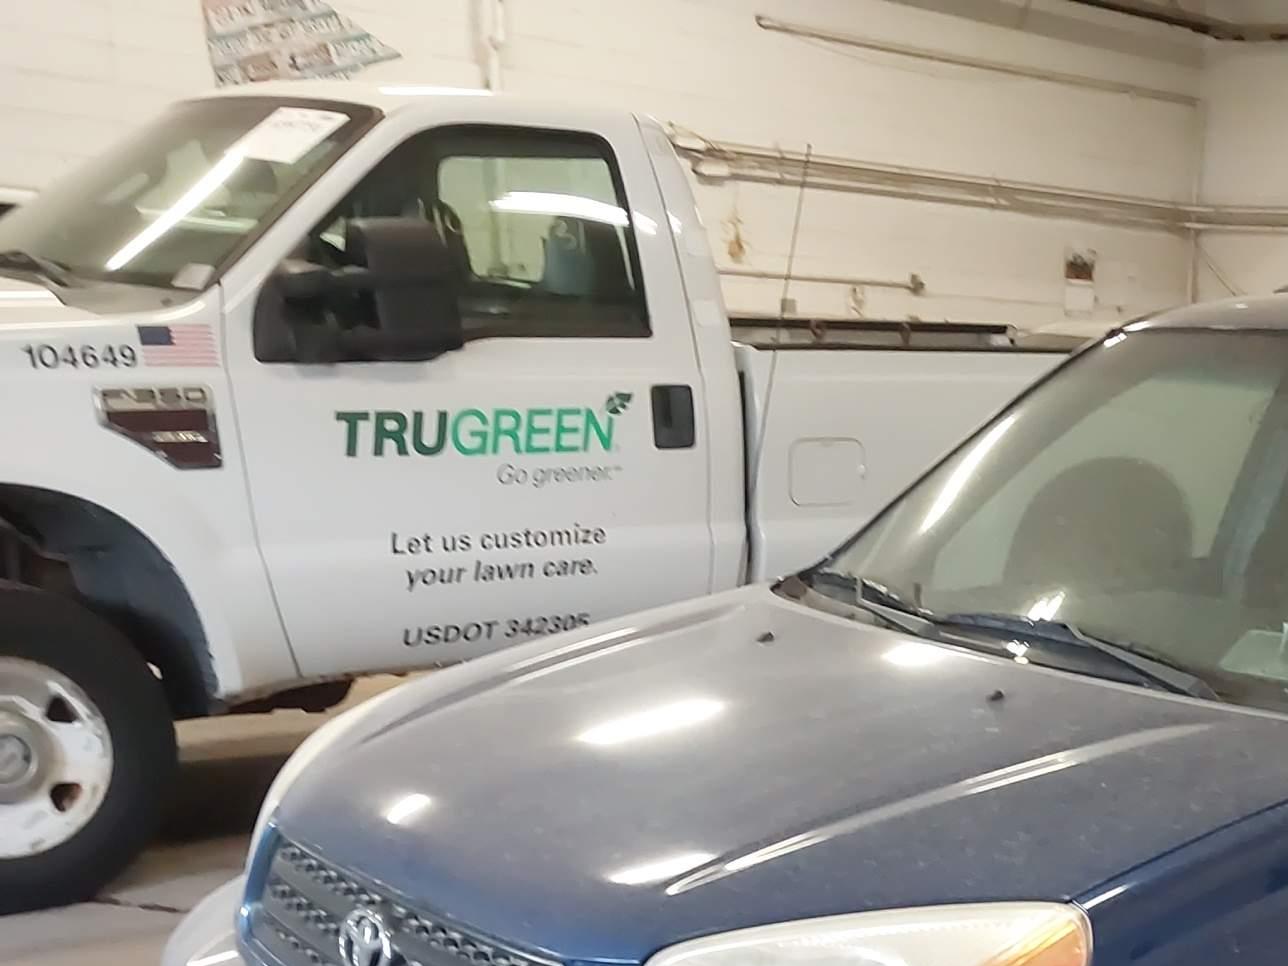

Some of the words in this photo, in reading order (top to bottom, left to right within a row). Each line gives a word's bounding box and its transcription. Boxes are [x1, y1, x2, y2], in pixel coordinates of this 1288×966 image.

[22, 344, 137, 369] 104649
[335, 407, 614, 457] TRUGREEN
[497, 463, 527, 485] Go
[391, 532, 432, 555] Let
[442, 535, 472, 552] us
[480, 522, 606, 551] customize
[406, 566, 464, 592] your
[474, 560, 535, 582] lawn
[543, 557, 598, 578] care.
[402, 620, 499, 647] USDOT
